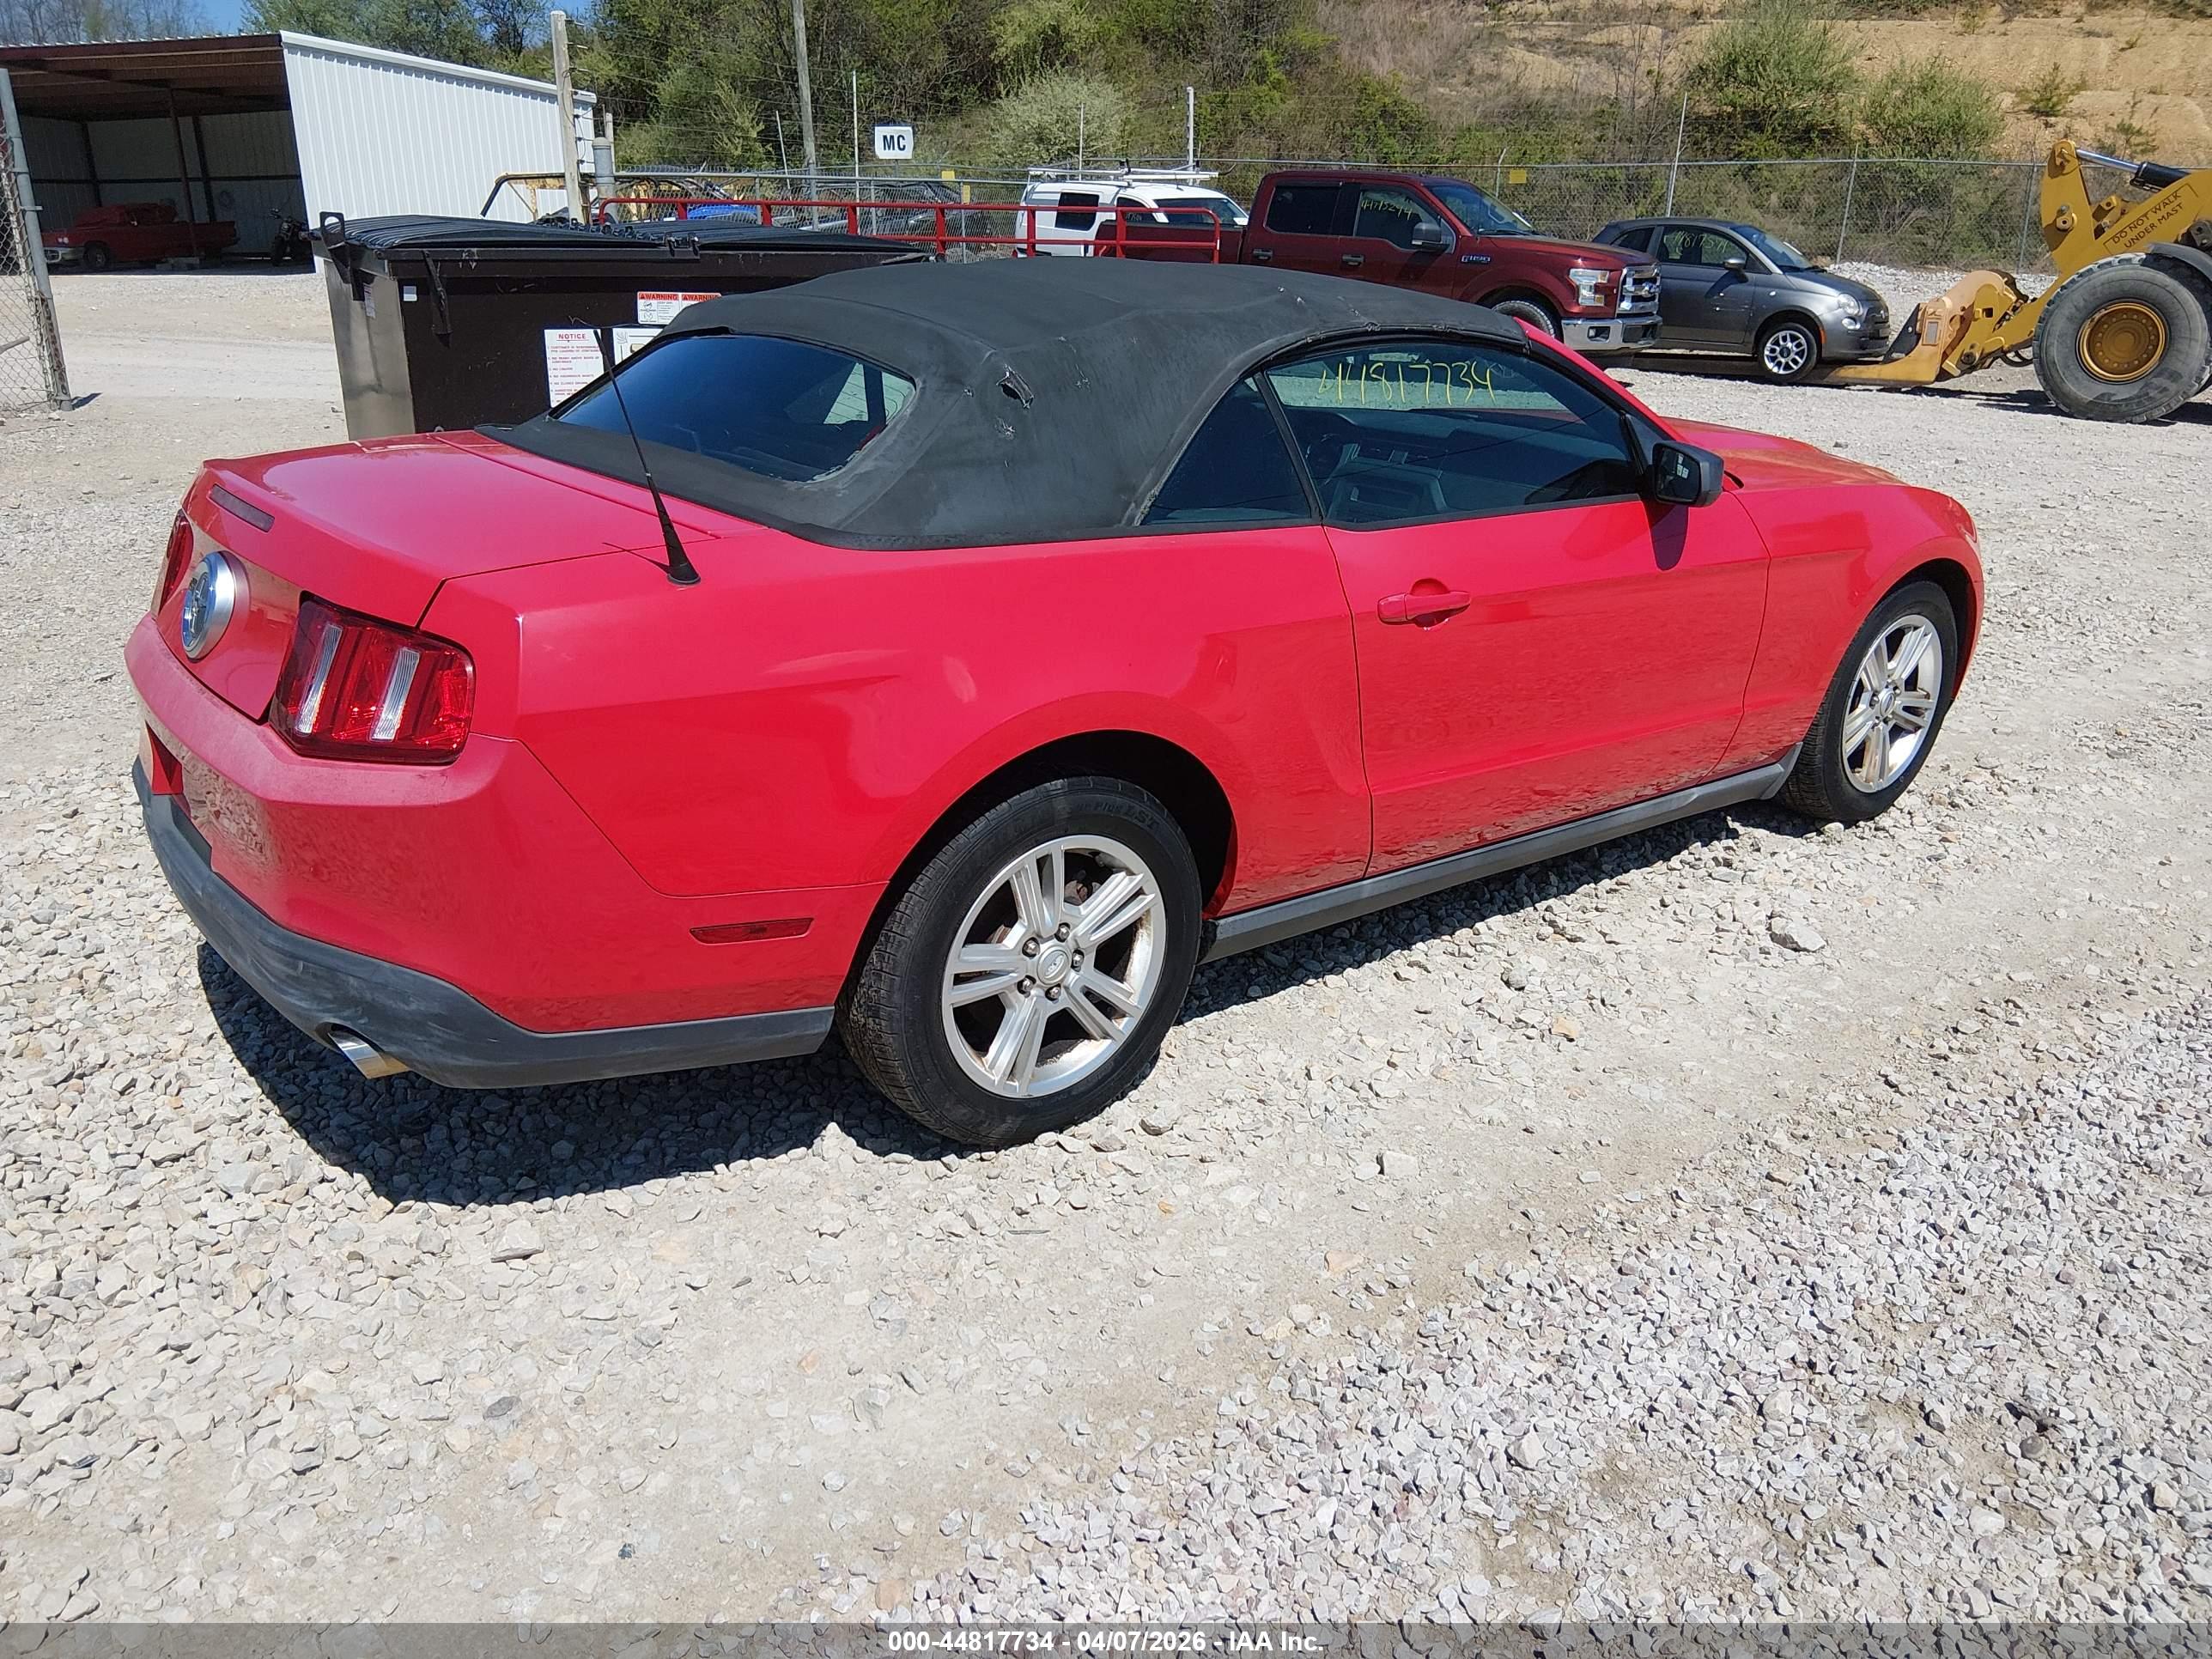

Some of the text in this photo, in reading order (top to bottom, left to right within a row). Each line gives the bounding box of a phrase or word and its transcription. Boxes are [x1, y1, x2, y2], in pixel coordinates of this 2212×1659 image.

[882, 134, 907, 151] MC
[2112, 191, 2182, 244] DO NOT WALK
[2124, 202, 2185, 248] UNDER MAST
[1318, 361, 1497, 406] 44817734
